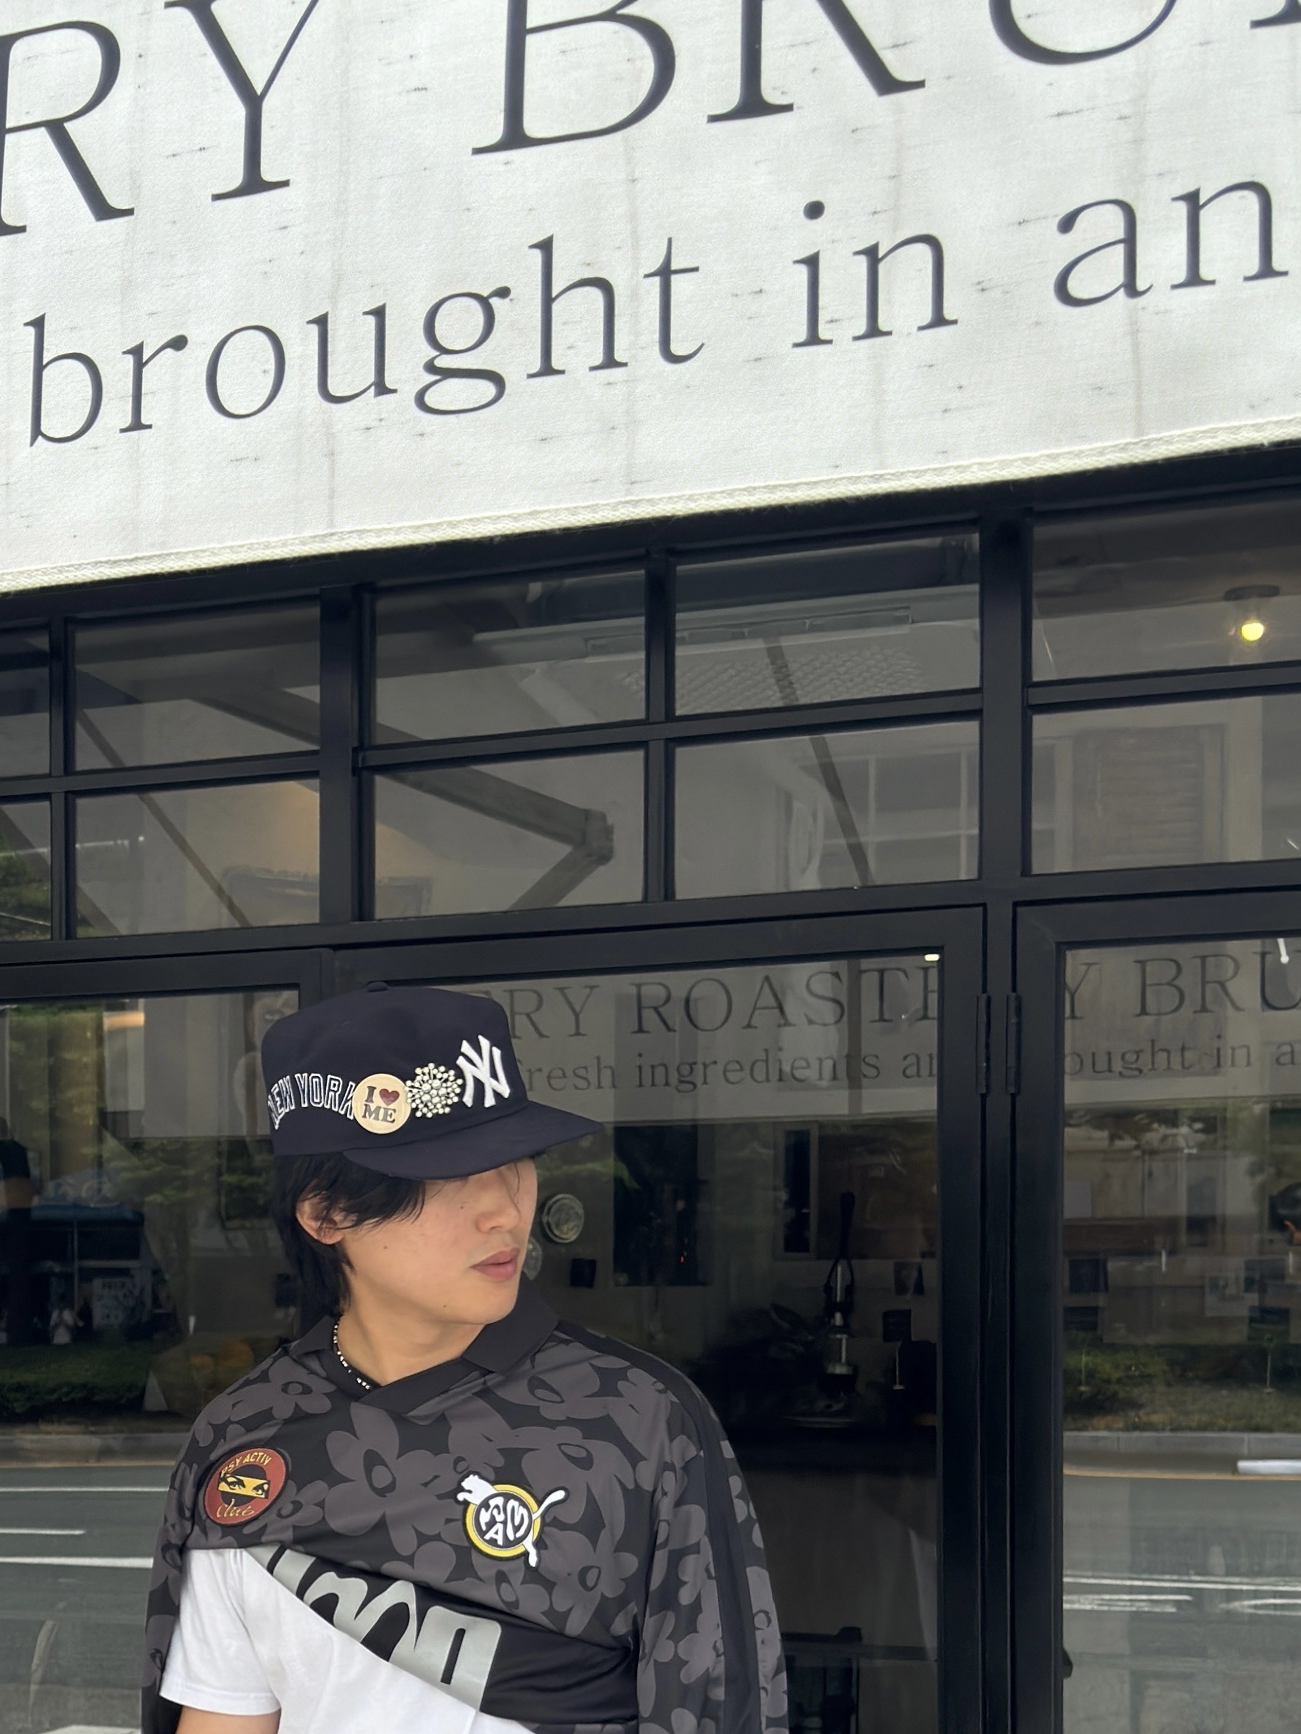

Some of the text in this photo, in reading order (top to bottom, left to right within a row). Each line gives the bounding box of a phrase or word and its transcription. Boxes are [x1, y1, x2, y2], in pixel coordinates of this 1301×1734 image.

[23, 234, 705, 447] brought
[792, 200, 958, 348] in
[1054, 180, 1290, 308] an
[518, 1055, 617, 1094] resh
[636, 1047, 882, 1095] ingrediens
[361, 1103, 397, 1124] ME
